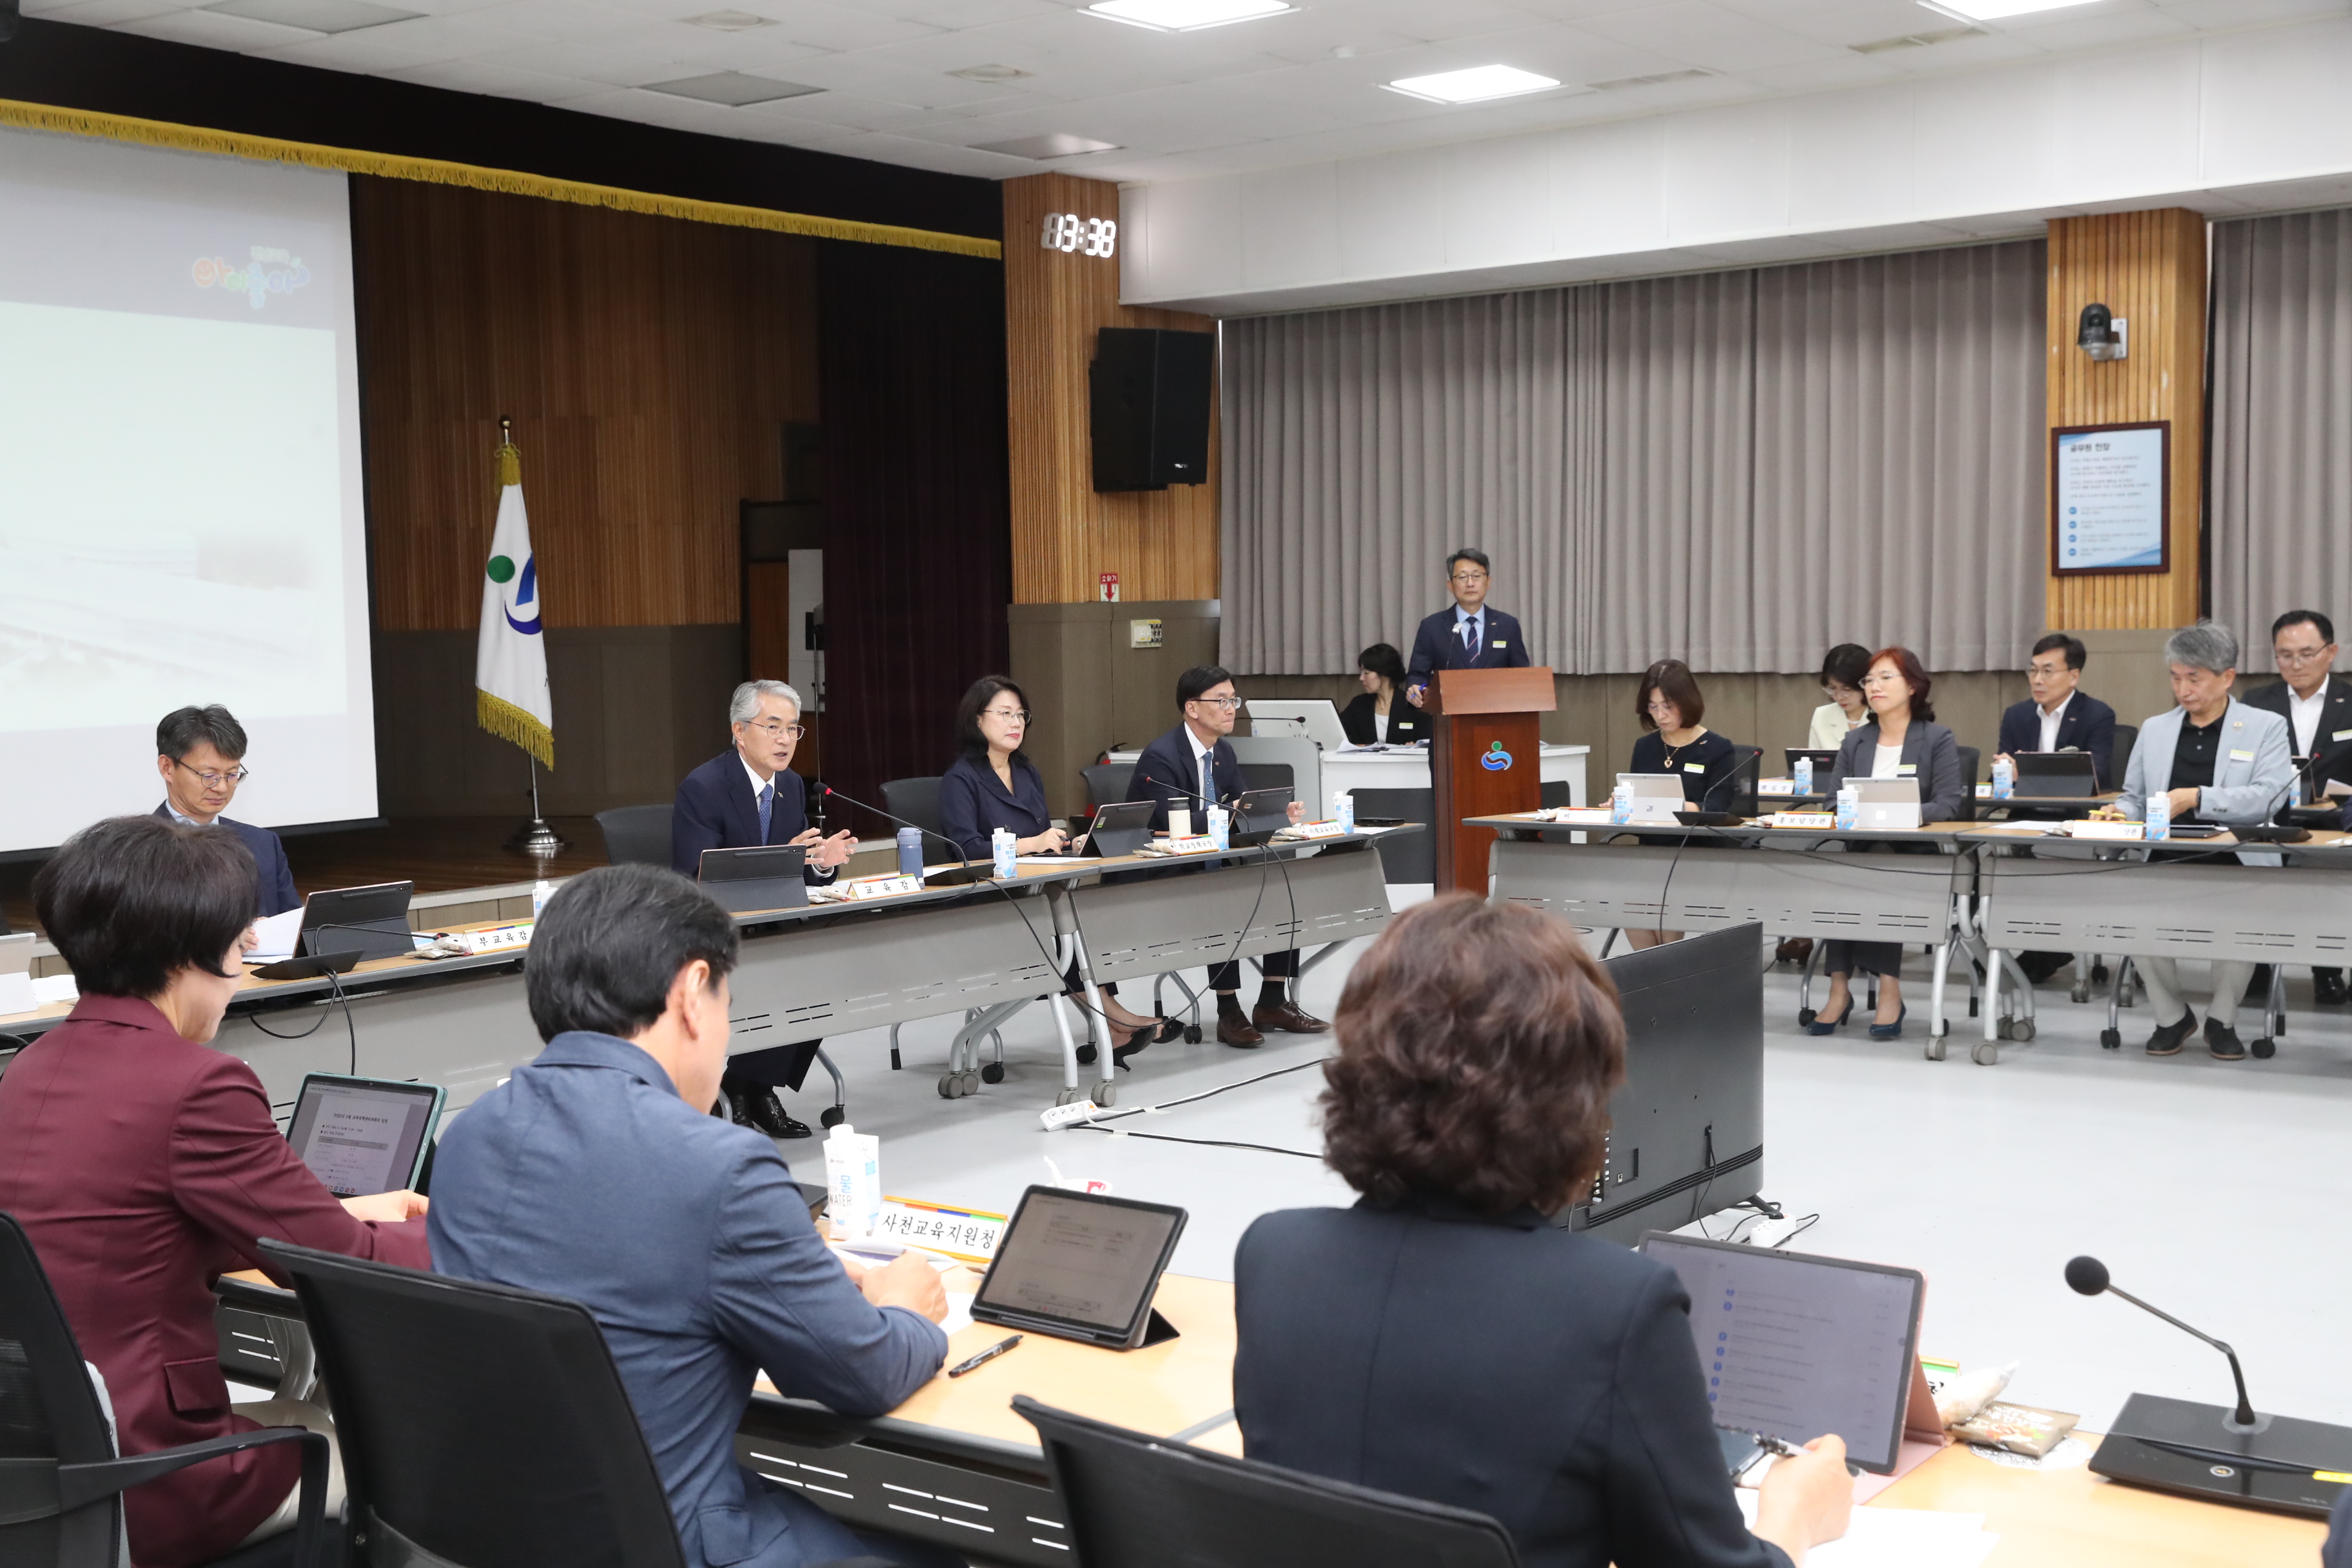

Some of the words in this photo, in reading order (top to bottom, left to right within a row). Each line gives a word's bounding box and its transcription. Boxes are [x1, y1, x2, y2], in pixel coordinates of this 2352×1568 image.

[1055, 214, 1117, 258] 13:38
[2070, 443, 2092, 452] 공무원
[1179, 839, 1213, 850] 학교정책국장
[839, 1175, 853, 1194] 물
[829, 1194, 852, 1207] WATER
[881, 1213, 995, 1250] 사천교육지원청
